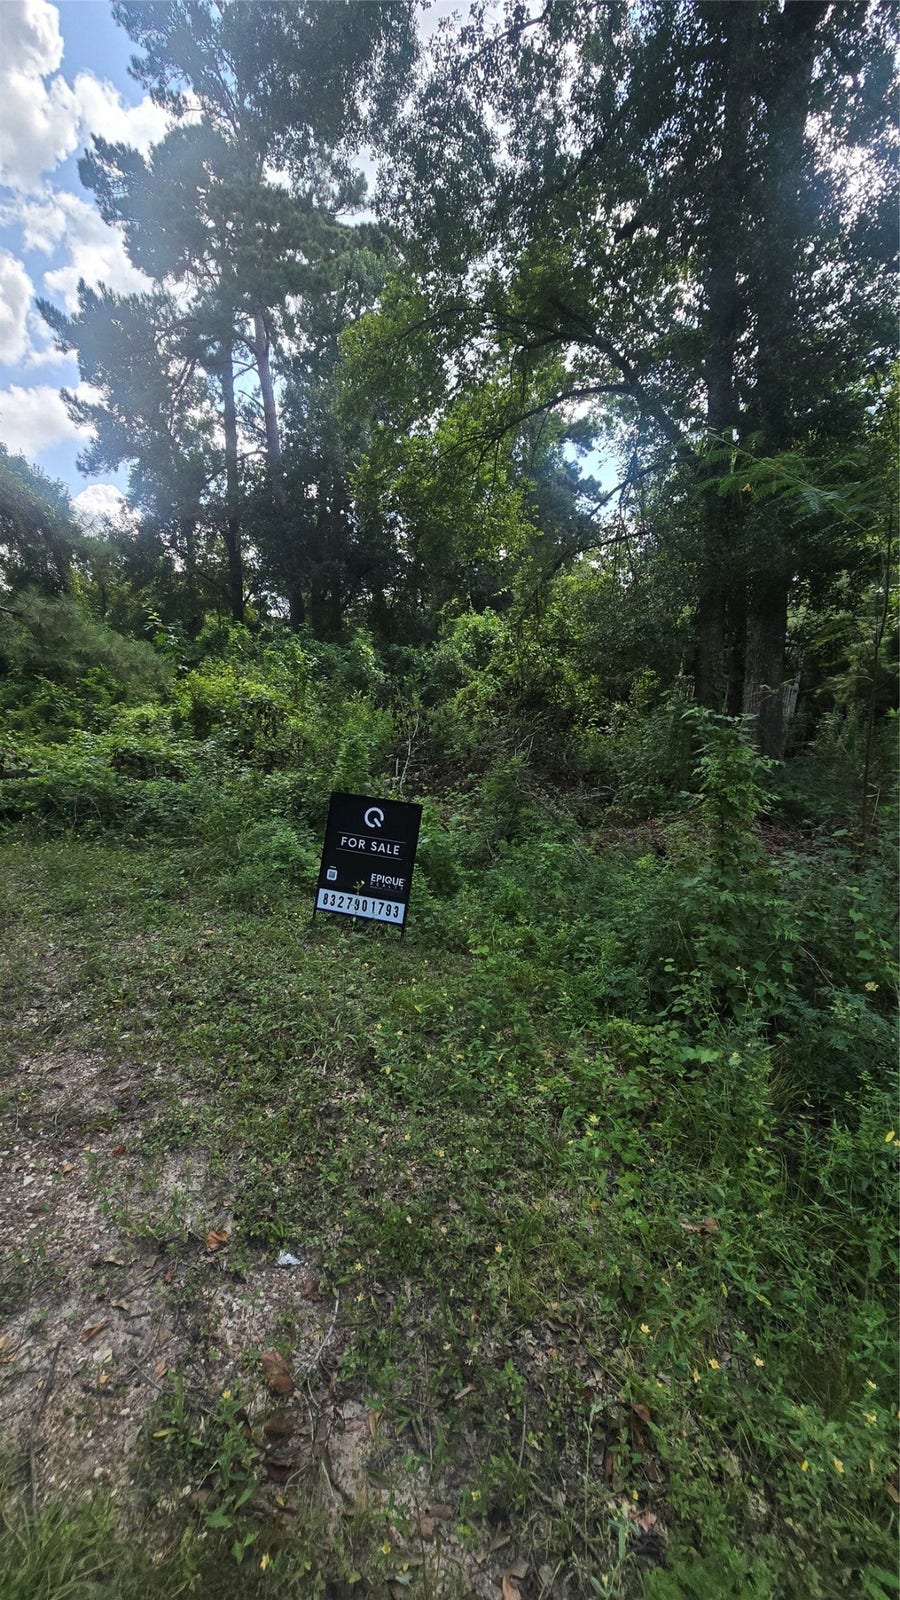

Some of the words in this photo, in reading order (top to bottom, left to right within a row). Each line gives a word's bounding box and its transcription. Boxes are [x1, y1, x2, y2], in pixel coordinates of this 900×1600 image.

[341, 836, 366, 850] FOR
[370, 841, 400, 855] SALE
[370, 873, 405, 887] EPIQUE
[322, 893, 400, 918] 8327901793
